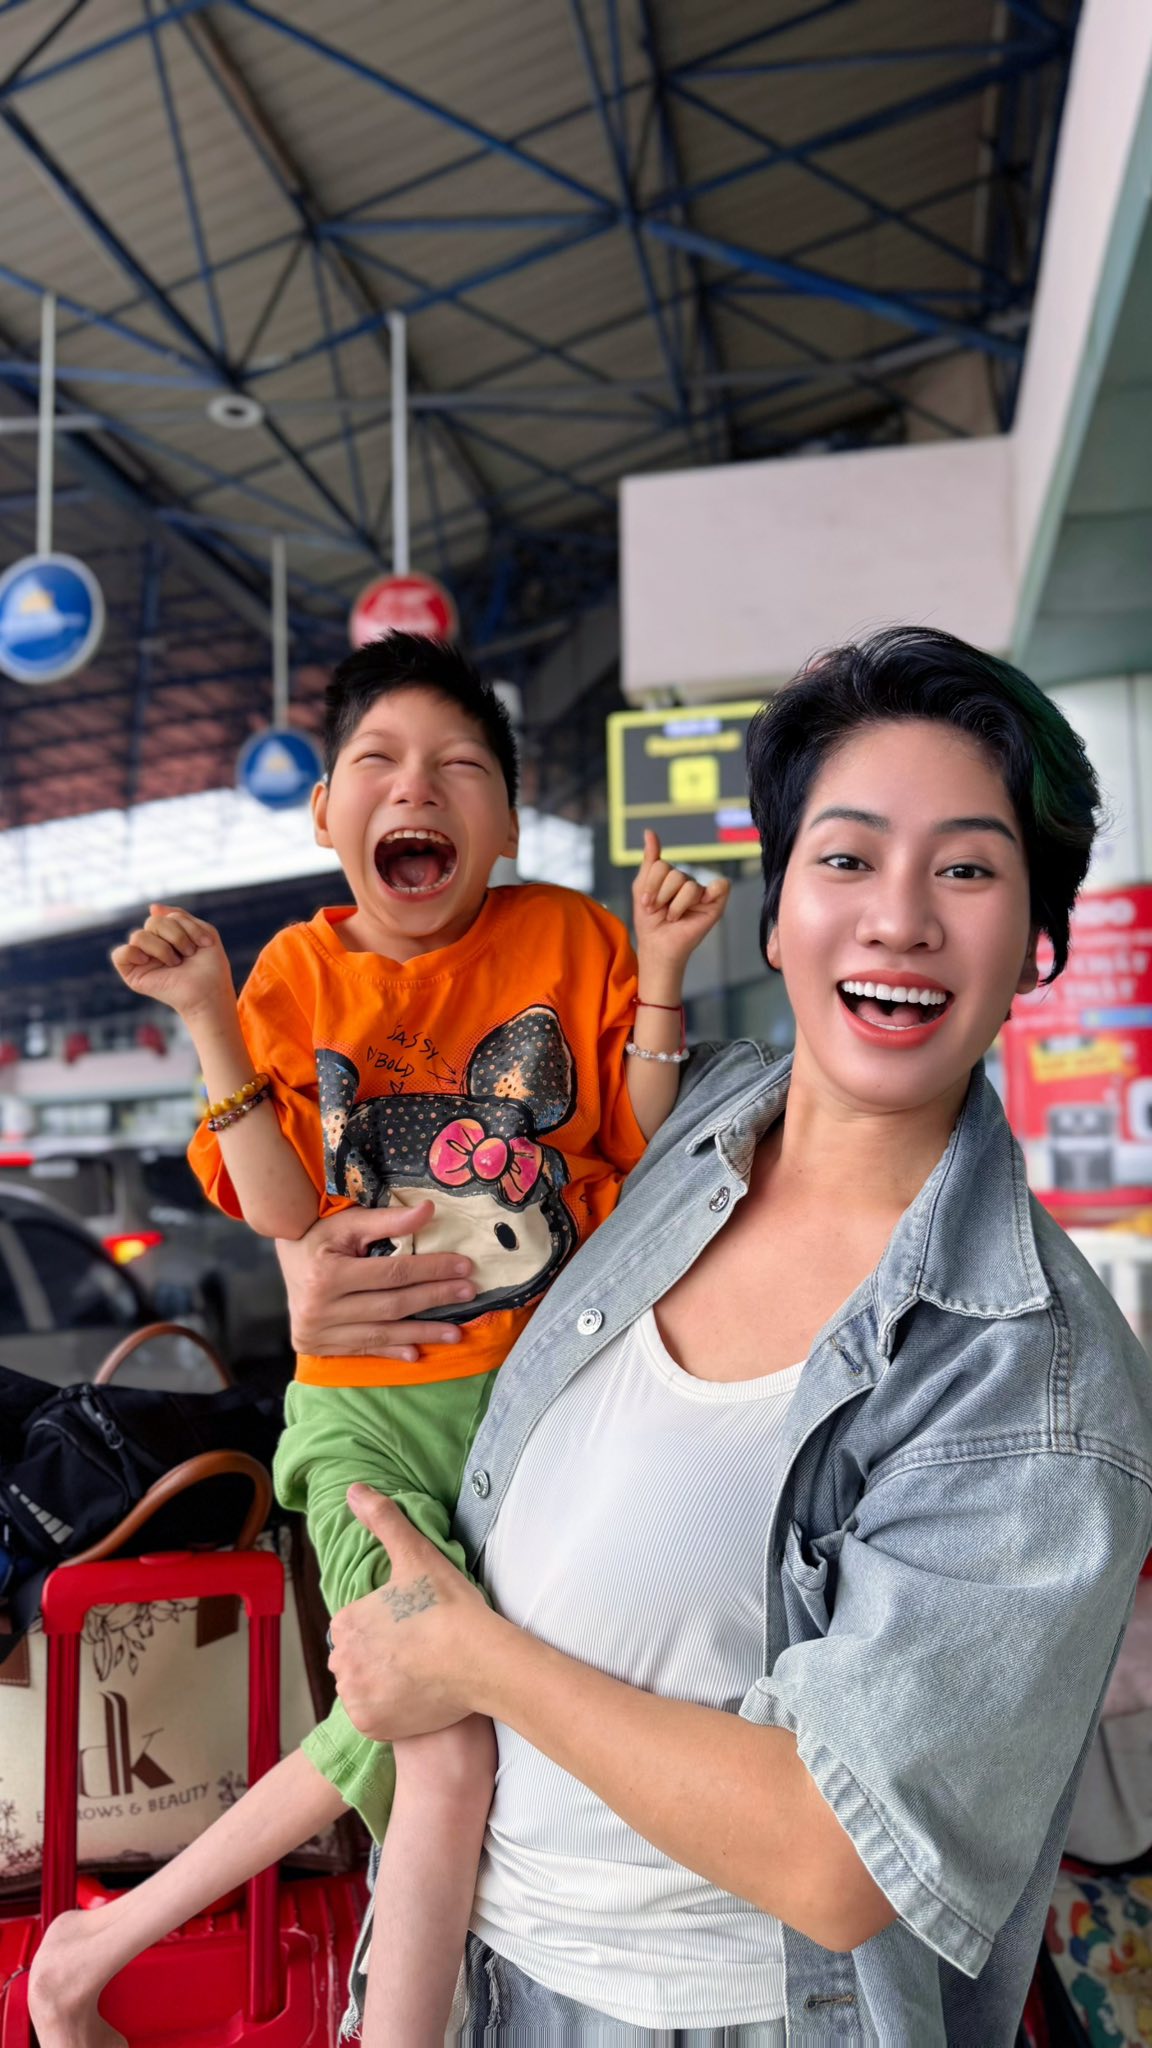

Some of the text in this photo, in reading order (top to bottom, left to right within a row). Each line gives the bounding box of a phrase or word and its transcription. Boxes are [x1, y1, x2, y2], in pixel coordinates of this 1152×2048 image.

[374, 1051, 415, 1078] BOLD
[129, 1802, 142, 1816] &
[147, 1782, 209, 1812] BEAUTY
